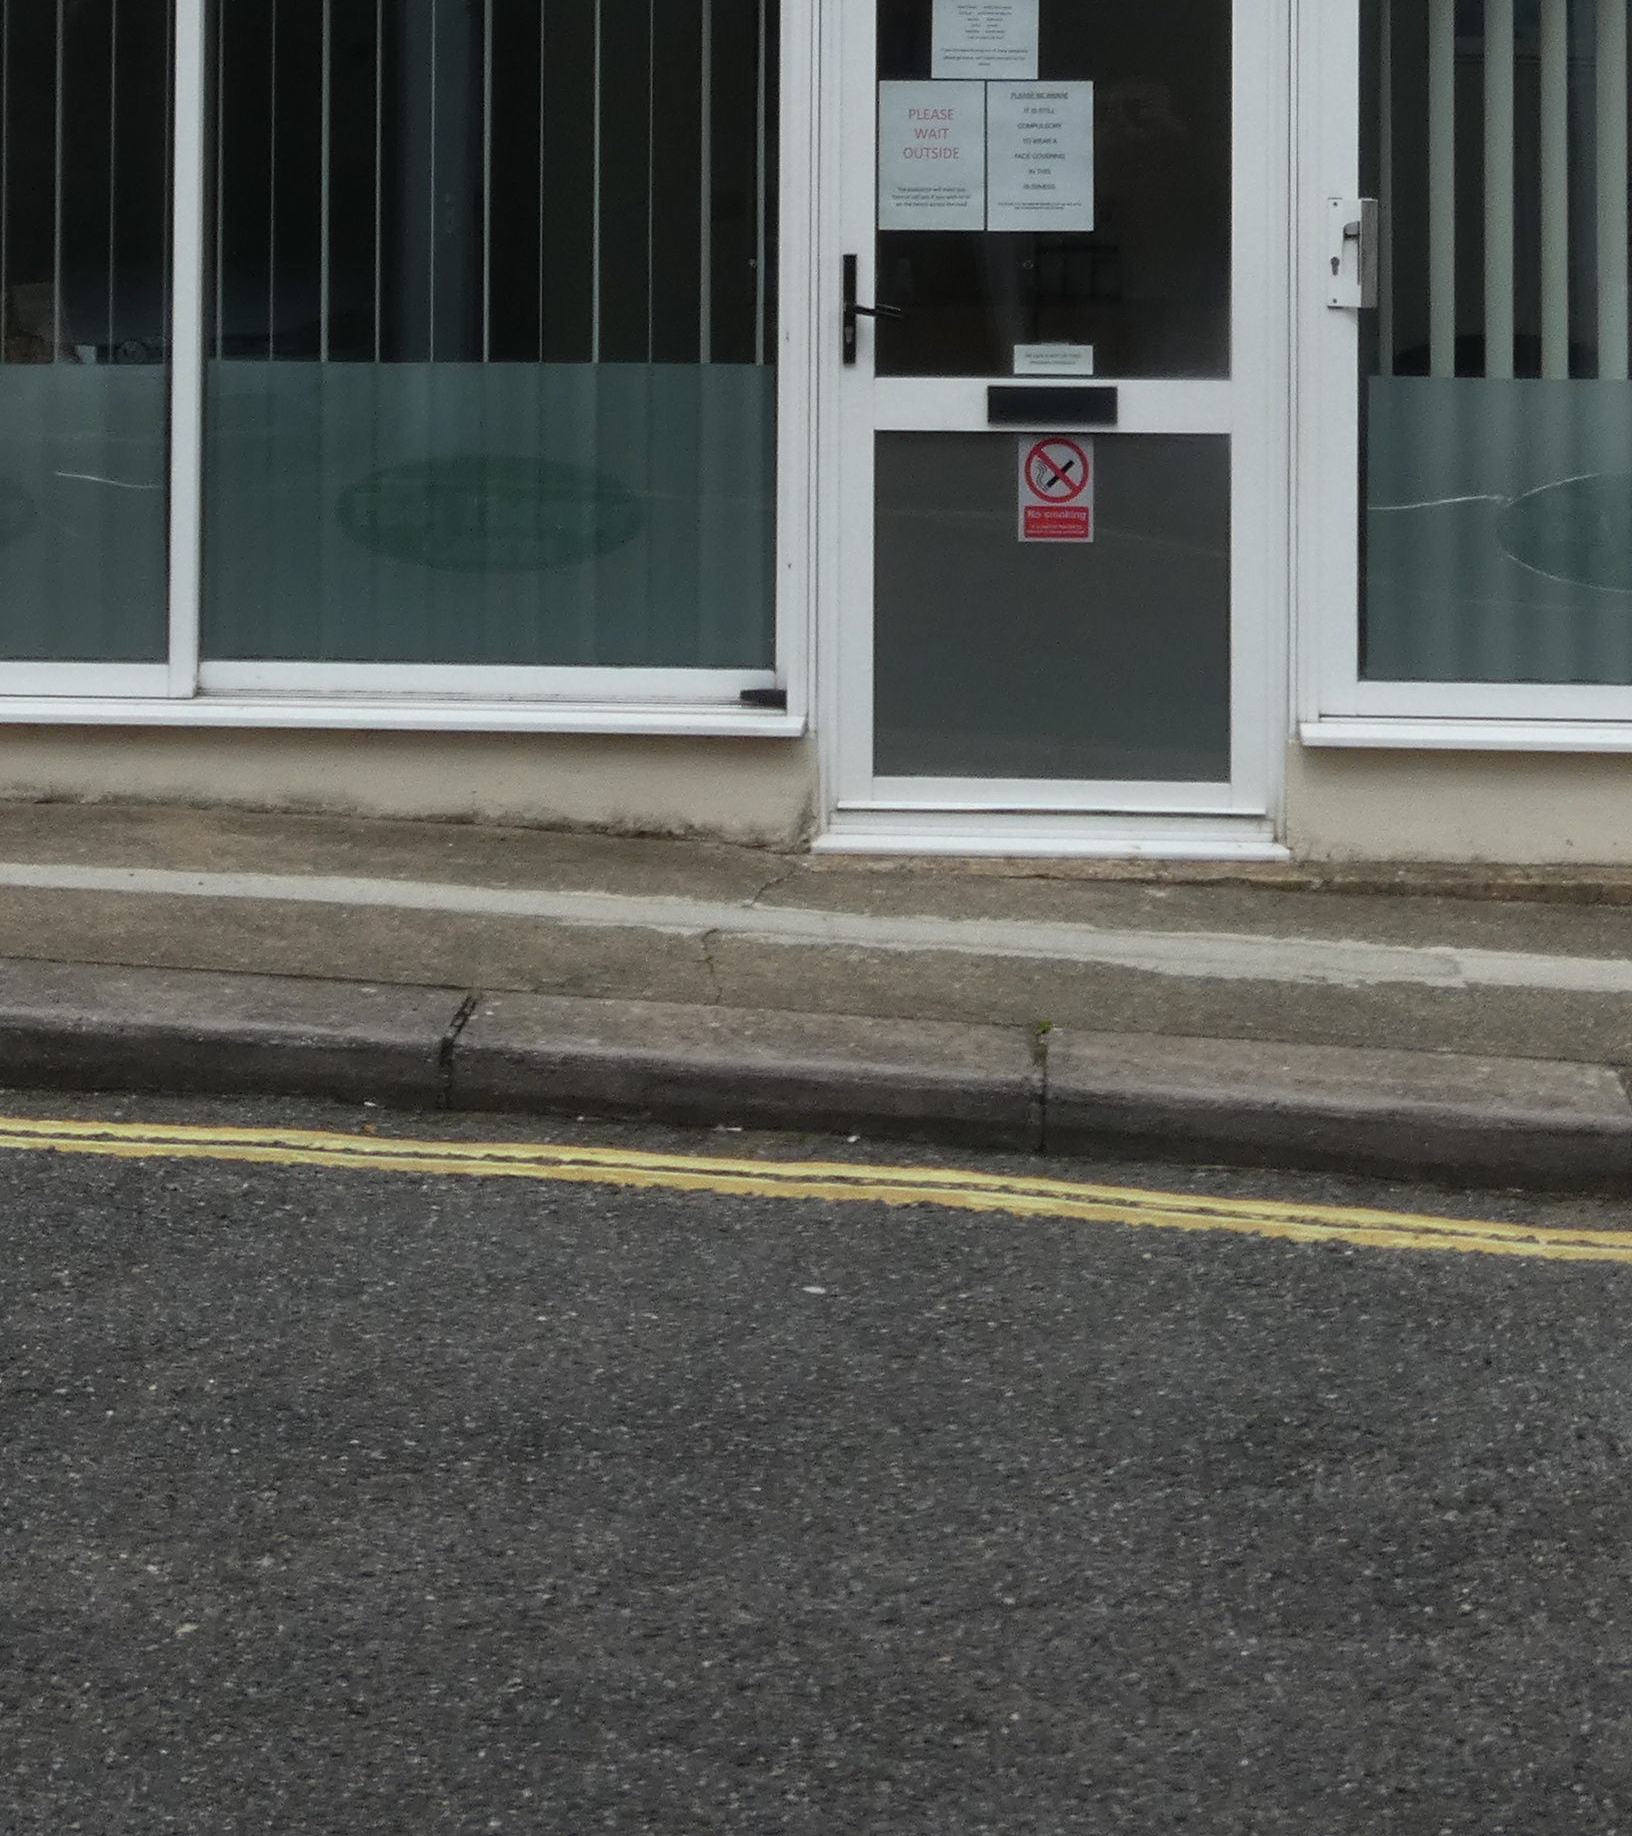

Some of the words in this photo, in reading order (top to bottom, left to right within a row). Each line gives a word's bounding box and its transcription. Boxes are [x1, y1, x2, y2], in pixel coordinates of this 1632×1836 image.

[908, 108, 954, 120] PLEASE
[914, 128, 949, 140] WAIT
[903, 147, 960, 159] OUTSIDE
